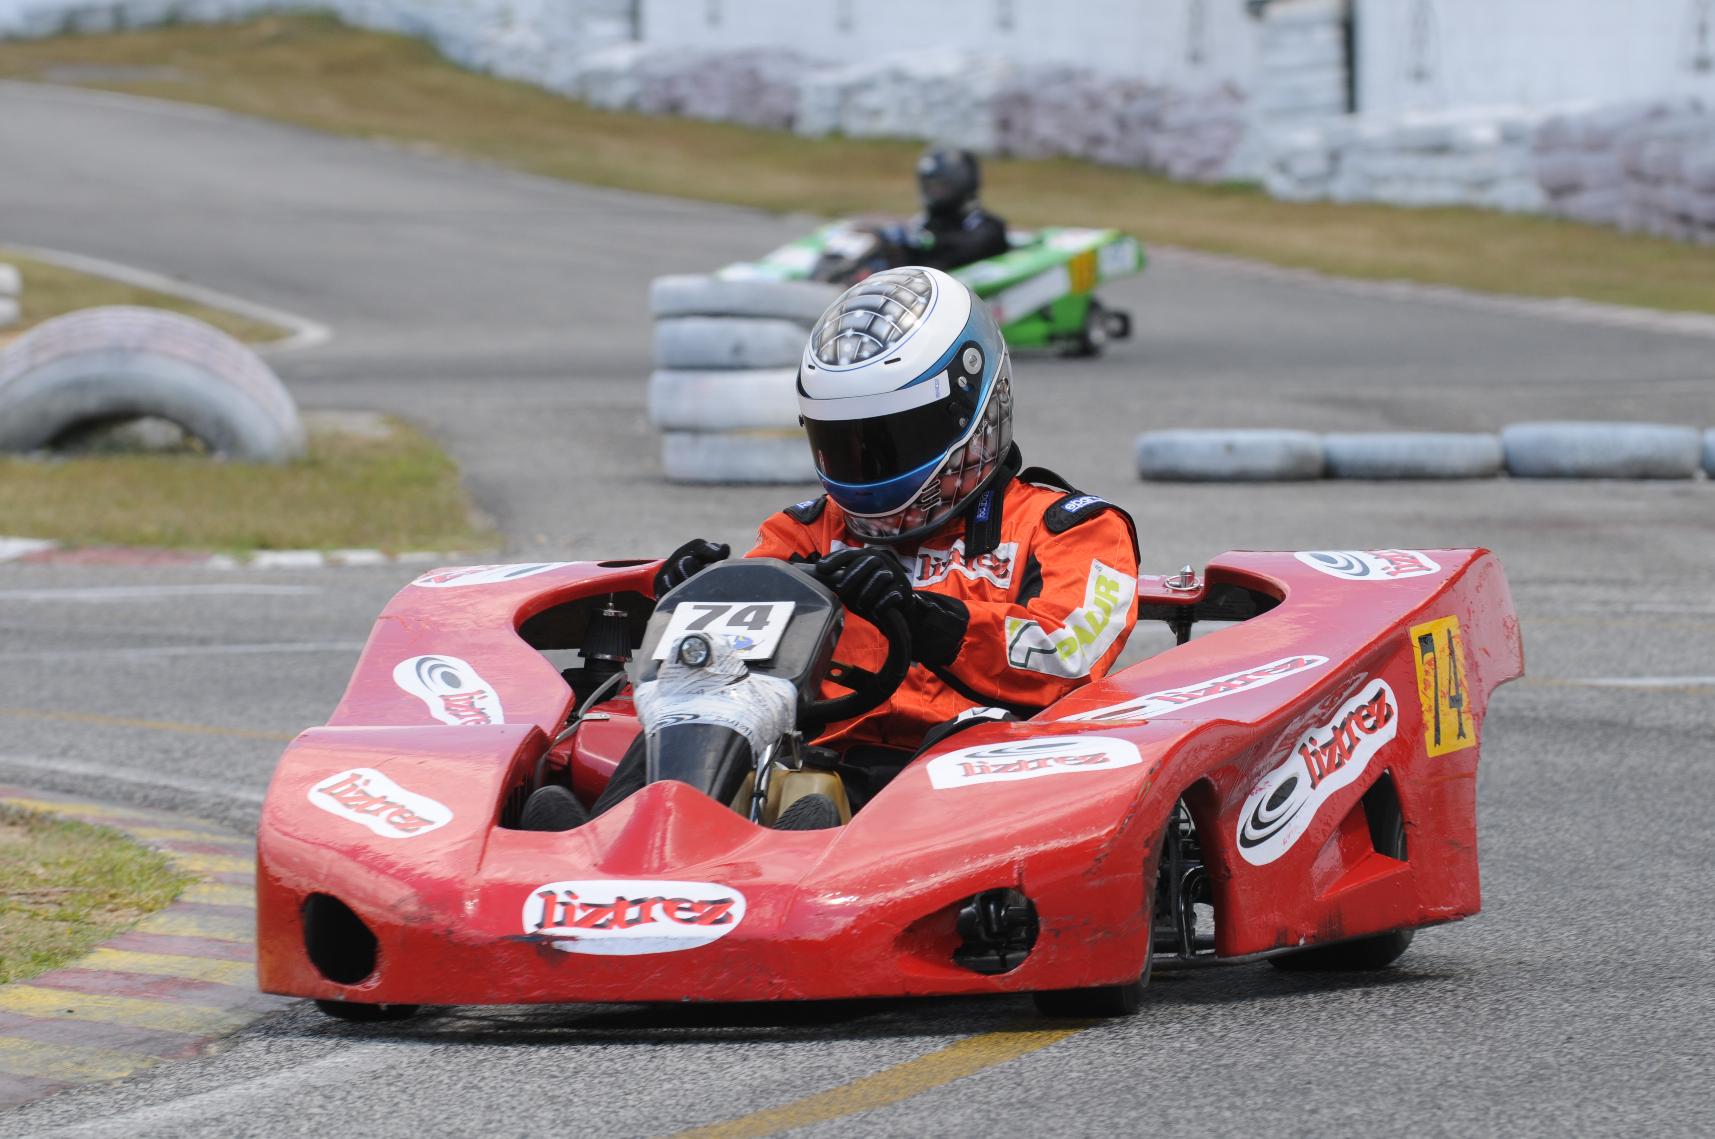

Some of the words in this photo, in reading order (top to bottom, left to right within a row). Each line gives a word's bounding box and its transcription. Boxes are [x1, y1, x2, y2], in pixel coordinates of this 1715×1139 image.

[684, 604, 774, 631] 74
[1298, 687, 1395, 791] liztrez
[960, 751, 1111, 778] liztrez
[317, 772, 436, 833] liztrez
[534, 890, 736, 930] liztrez
